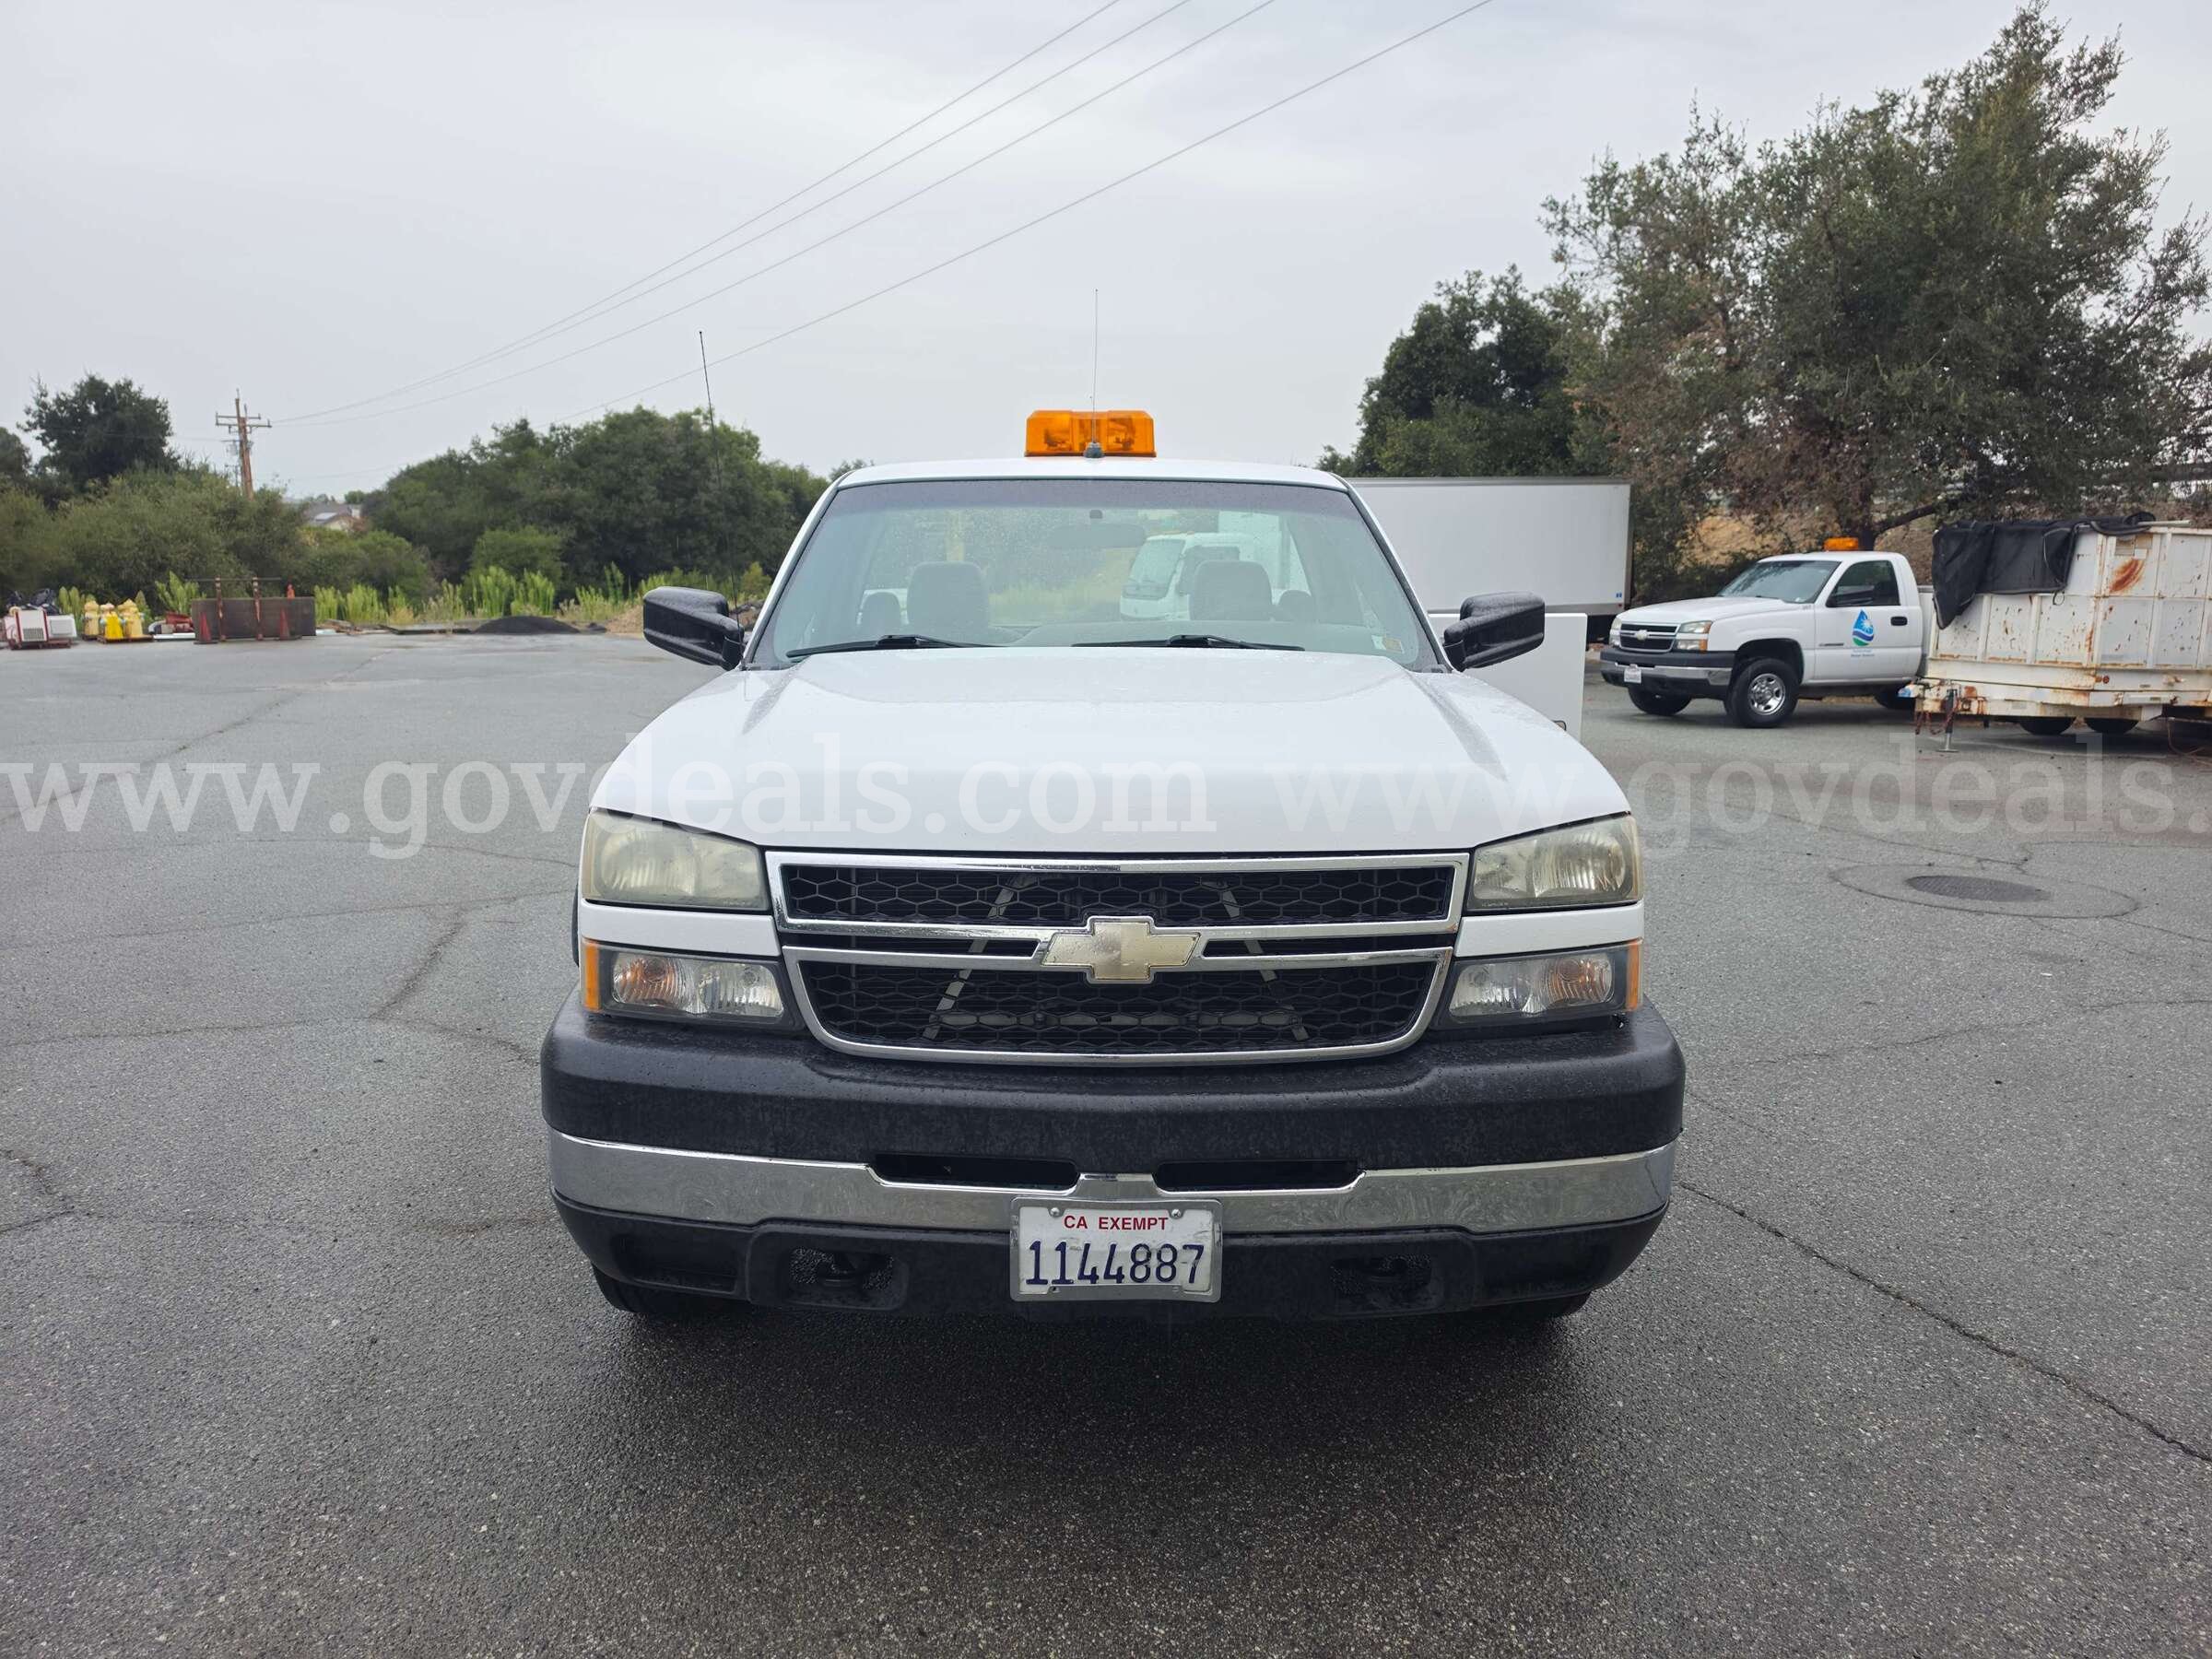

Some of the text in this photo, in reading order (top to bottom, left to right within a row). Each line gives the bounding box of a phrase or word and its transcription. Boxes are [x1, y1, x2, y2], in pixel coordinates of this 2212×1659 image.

[1064, 1215, 1169, 1231] CA EXEMPT
[1025, 1239, 1205, 1286] 1144887
